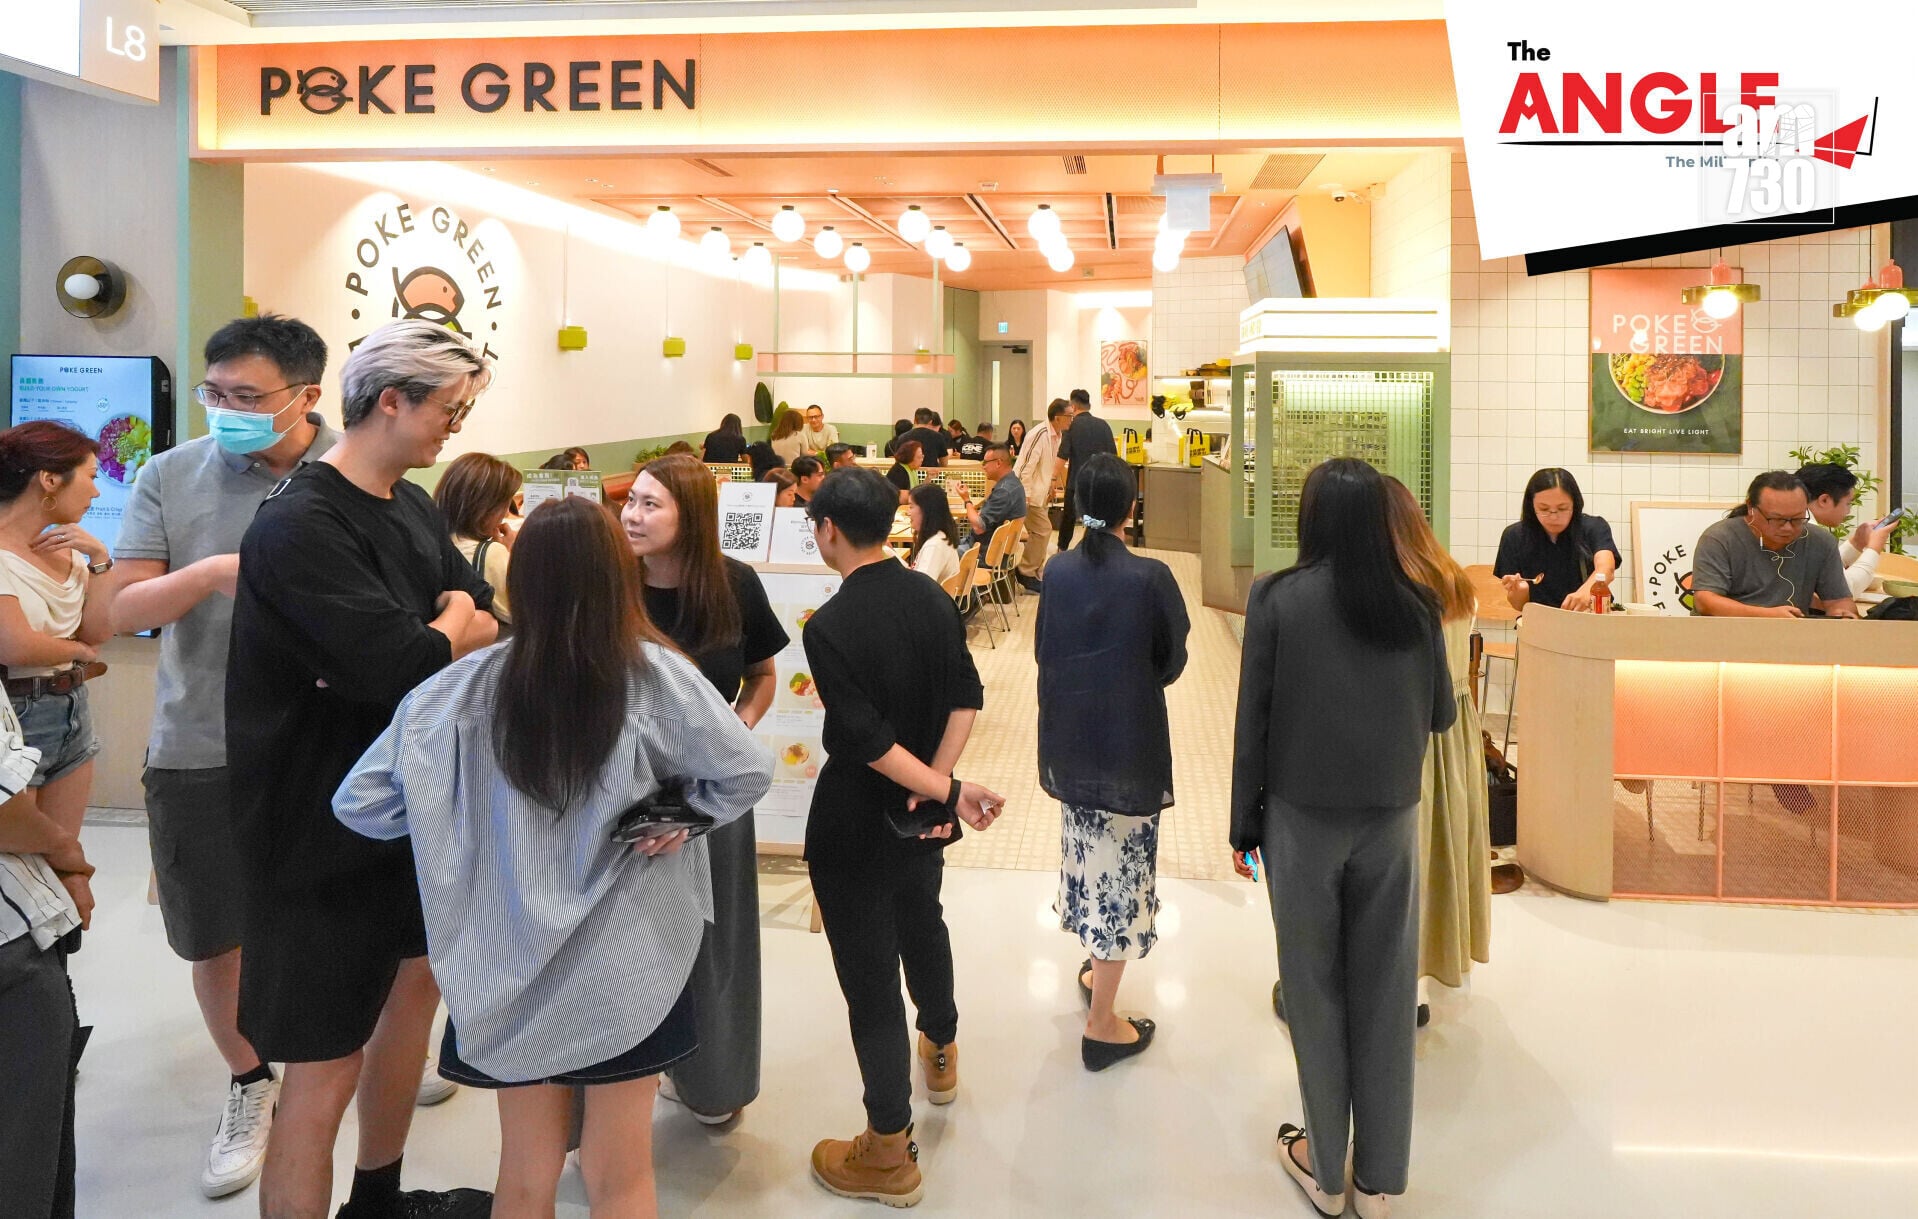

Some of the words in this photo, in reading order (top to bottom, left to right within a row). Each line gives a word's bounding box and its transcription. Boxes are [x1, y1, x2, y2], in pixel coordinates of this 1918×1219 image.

[105, 15, 147, 62] L8
[260, 64, 436, 116] POKE
[460, 58, 696, 114] GREEN
[345, 203, 415, 297] POKE
[432, 206, 502, 310] GREEN
[1613, 314, 1688, 334] POKE
[1629, 335, 1723, 354] GREEN
[1649, 544, 1687, 587] POKE
